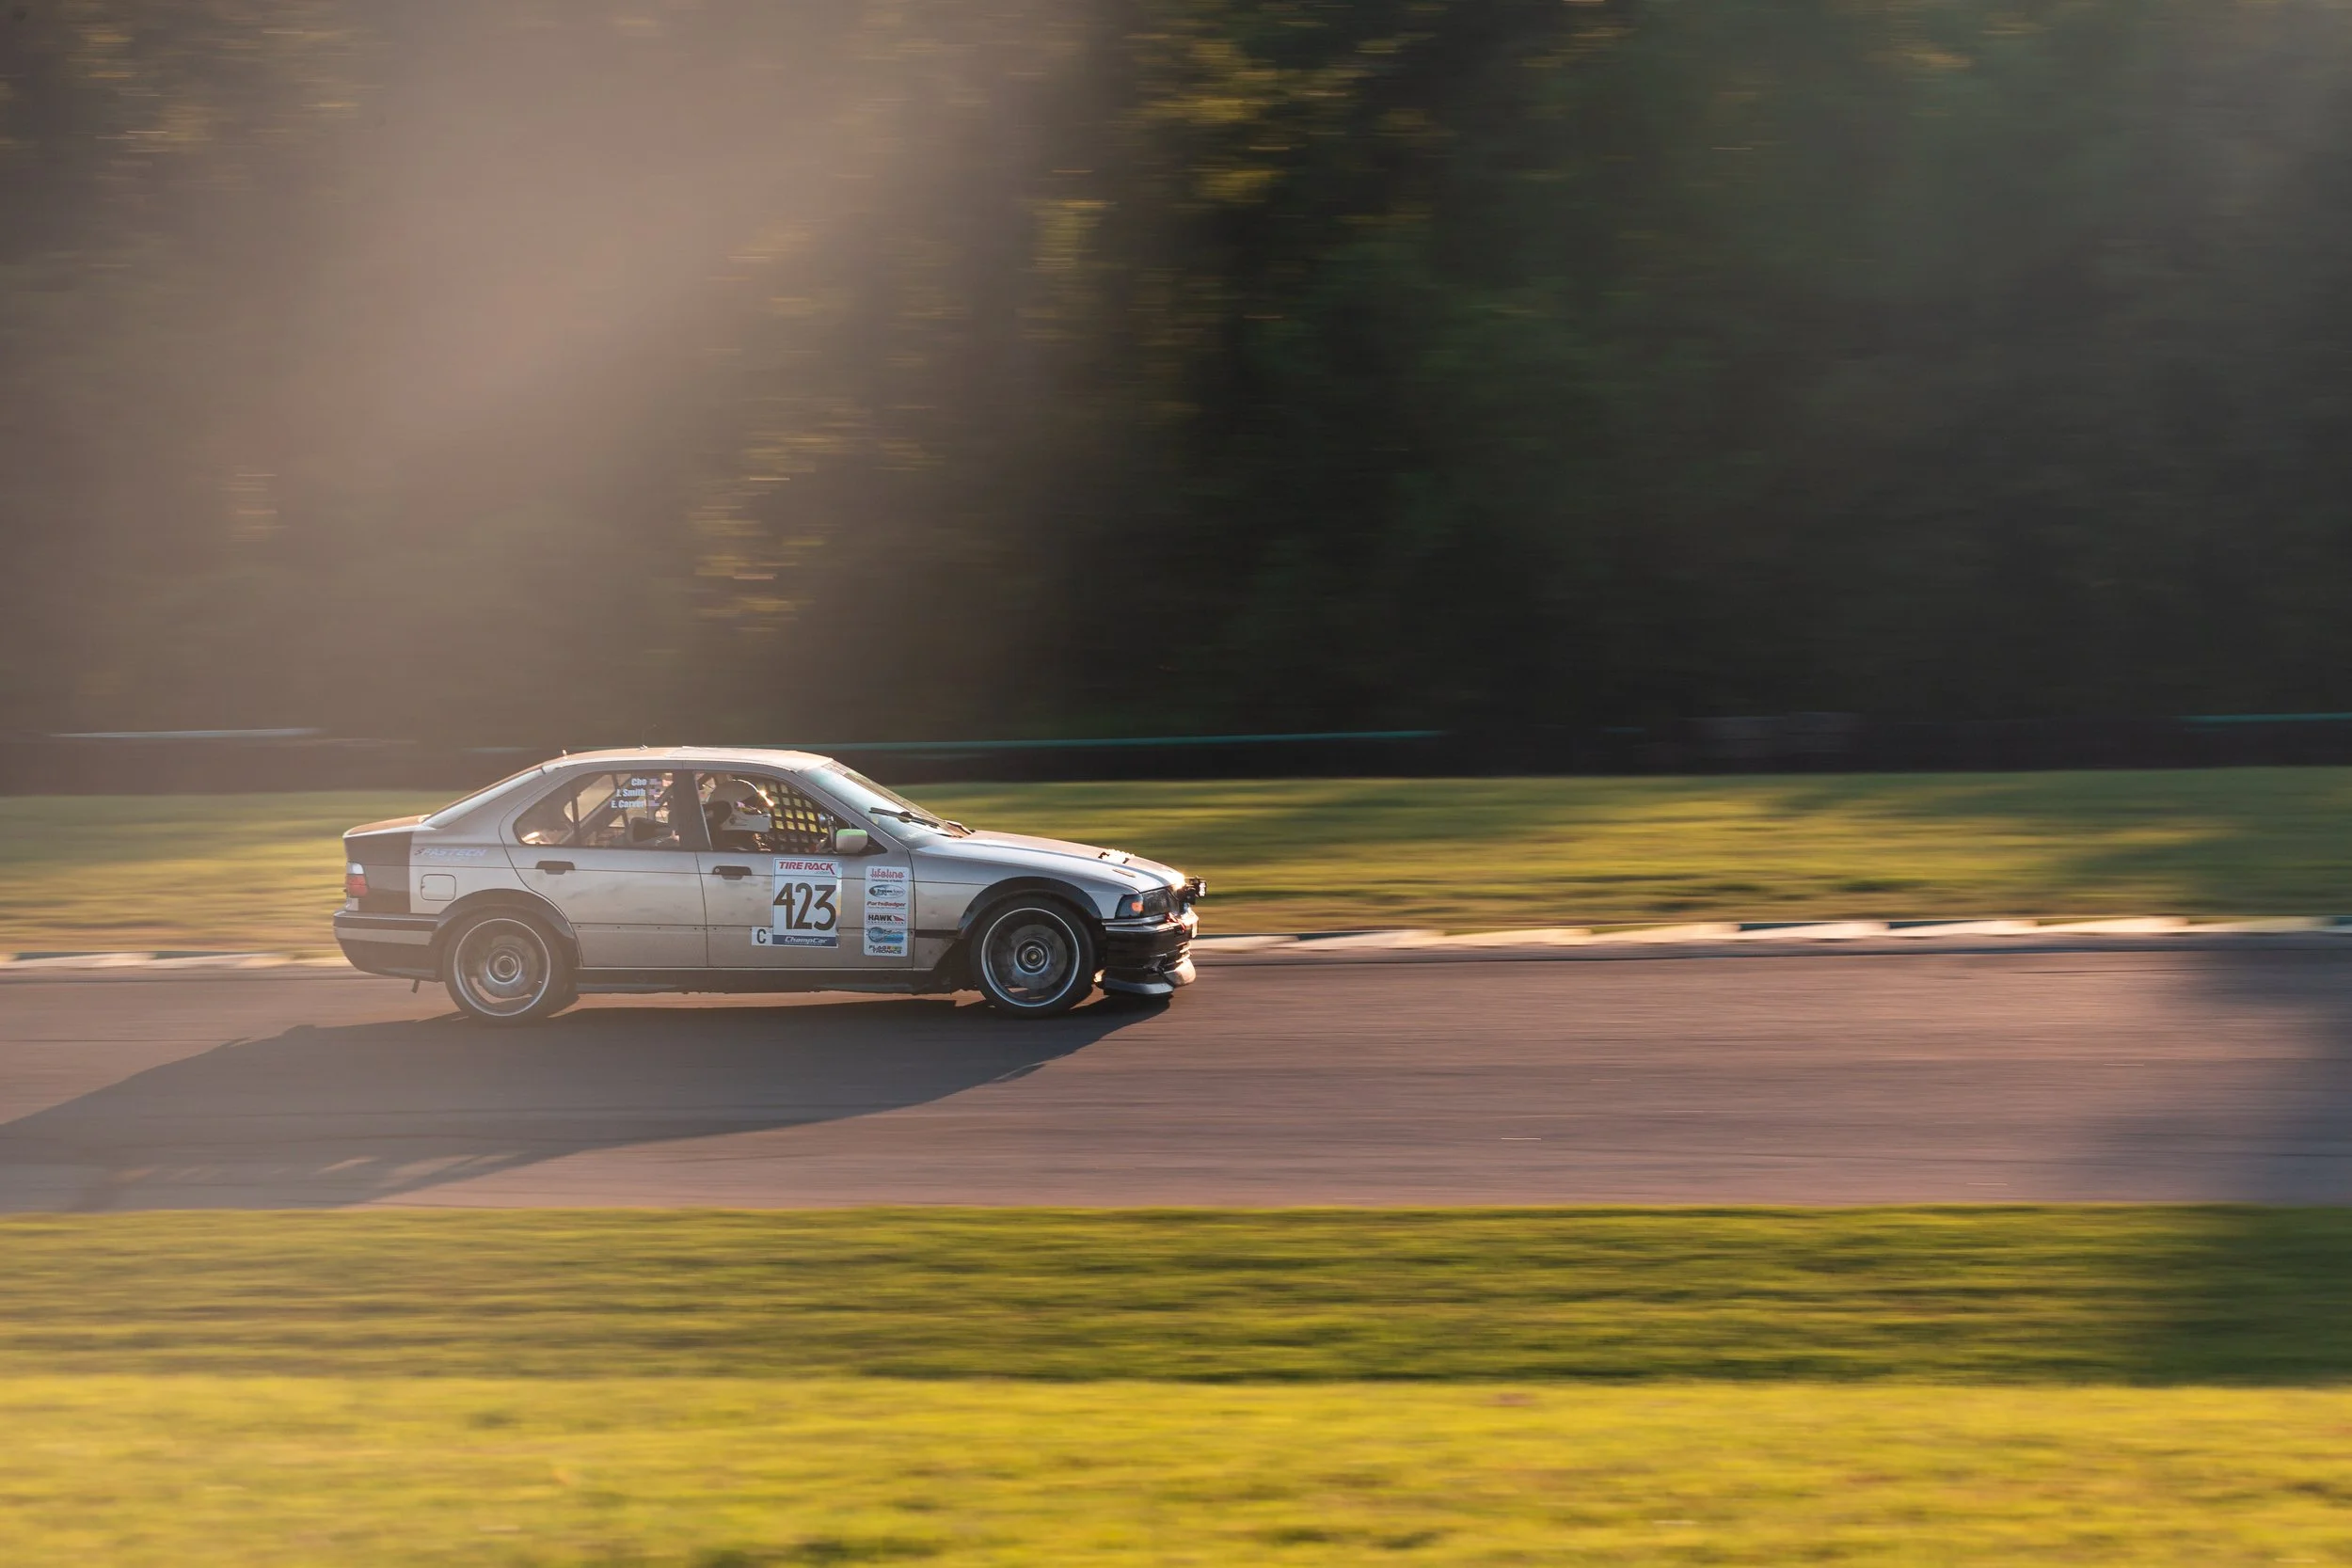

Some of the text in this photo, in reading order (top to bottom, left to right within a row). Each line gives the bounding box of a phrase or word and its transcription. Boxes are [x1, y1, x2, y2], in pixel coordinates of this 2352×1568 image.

[622, 788, 646, 797] Smith
[779, 861, 835, 875] TIRE RACK
[772, 882, 836, 931] 423
[756, 928, 767, 943] C
[785, 936, 827, 944] ChampCar
